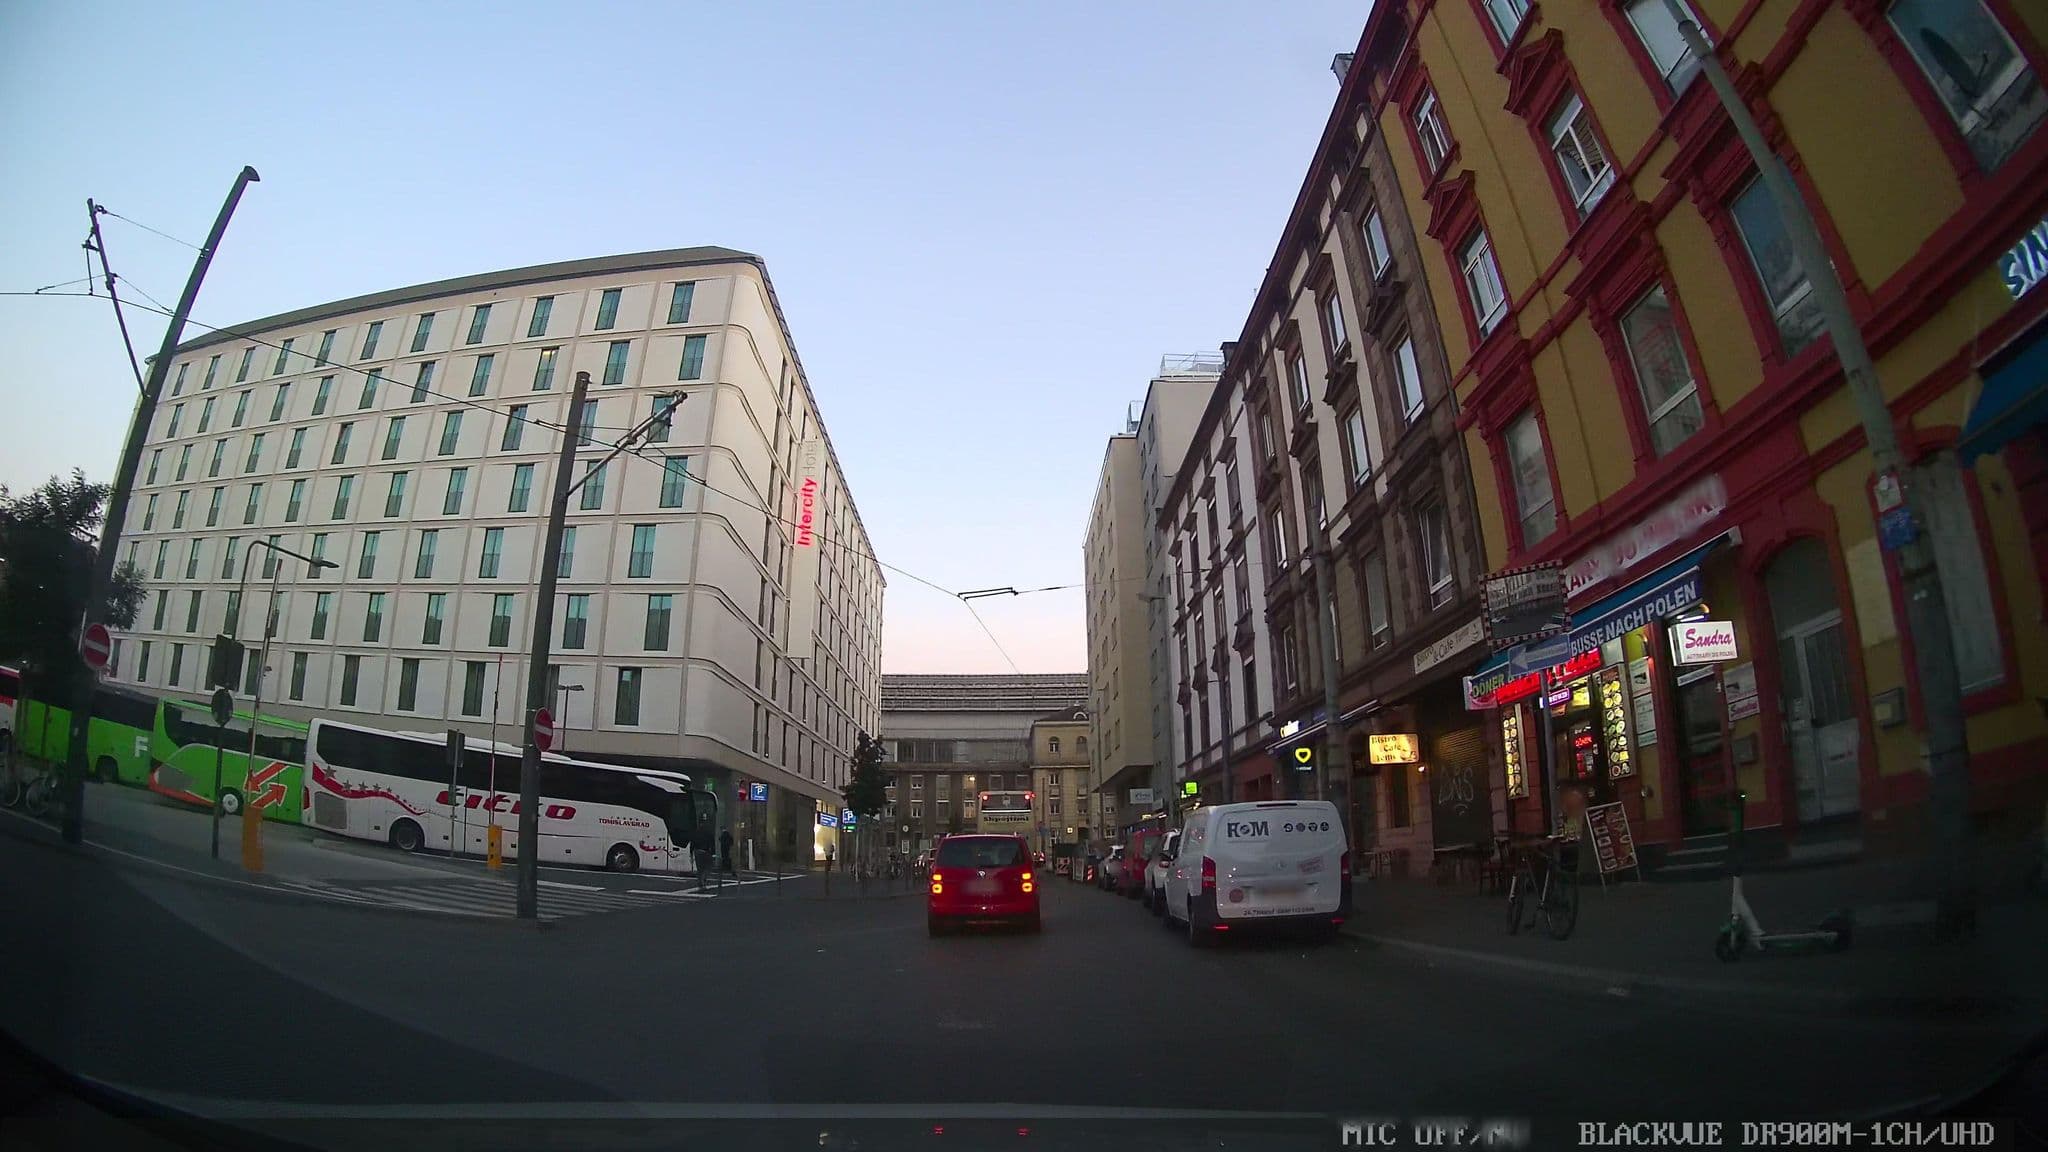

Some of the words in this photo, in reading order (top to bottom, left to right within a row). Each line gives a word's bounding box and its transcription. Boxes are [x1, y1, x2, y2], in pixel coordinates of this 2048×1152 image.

[801, 440, 817, 476] Hotel
[796, 478, 818, 546] Intercity
[1570, 627, 1605, 658] BUSSE
[1605, 612, 1644, 644] NACH
[1645, 581, 1697, 622] POLEN
[1685, 628, 1732, 649] Sandra
[599, 817, 650, 829] TOMISLAVGRAD
